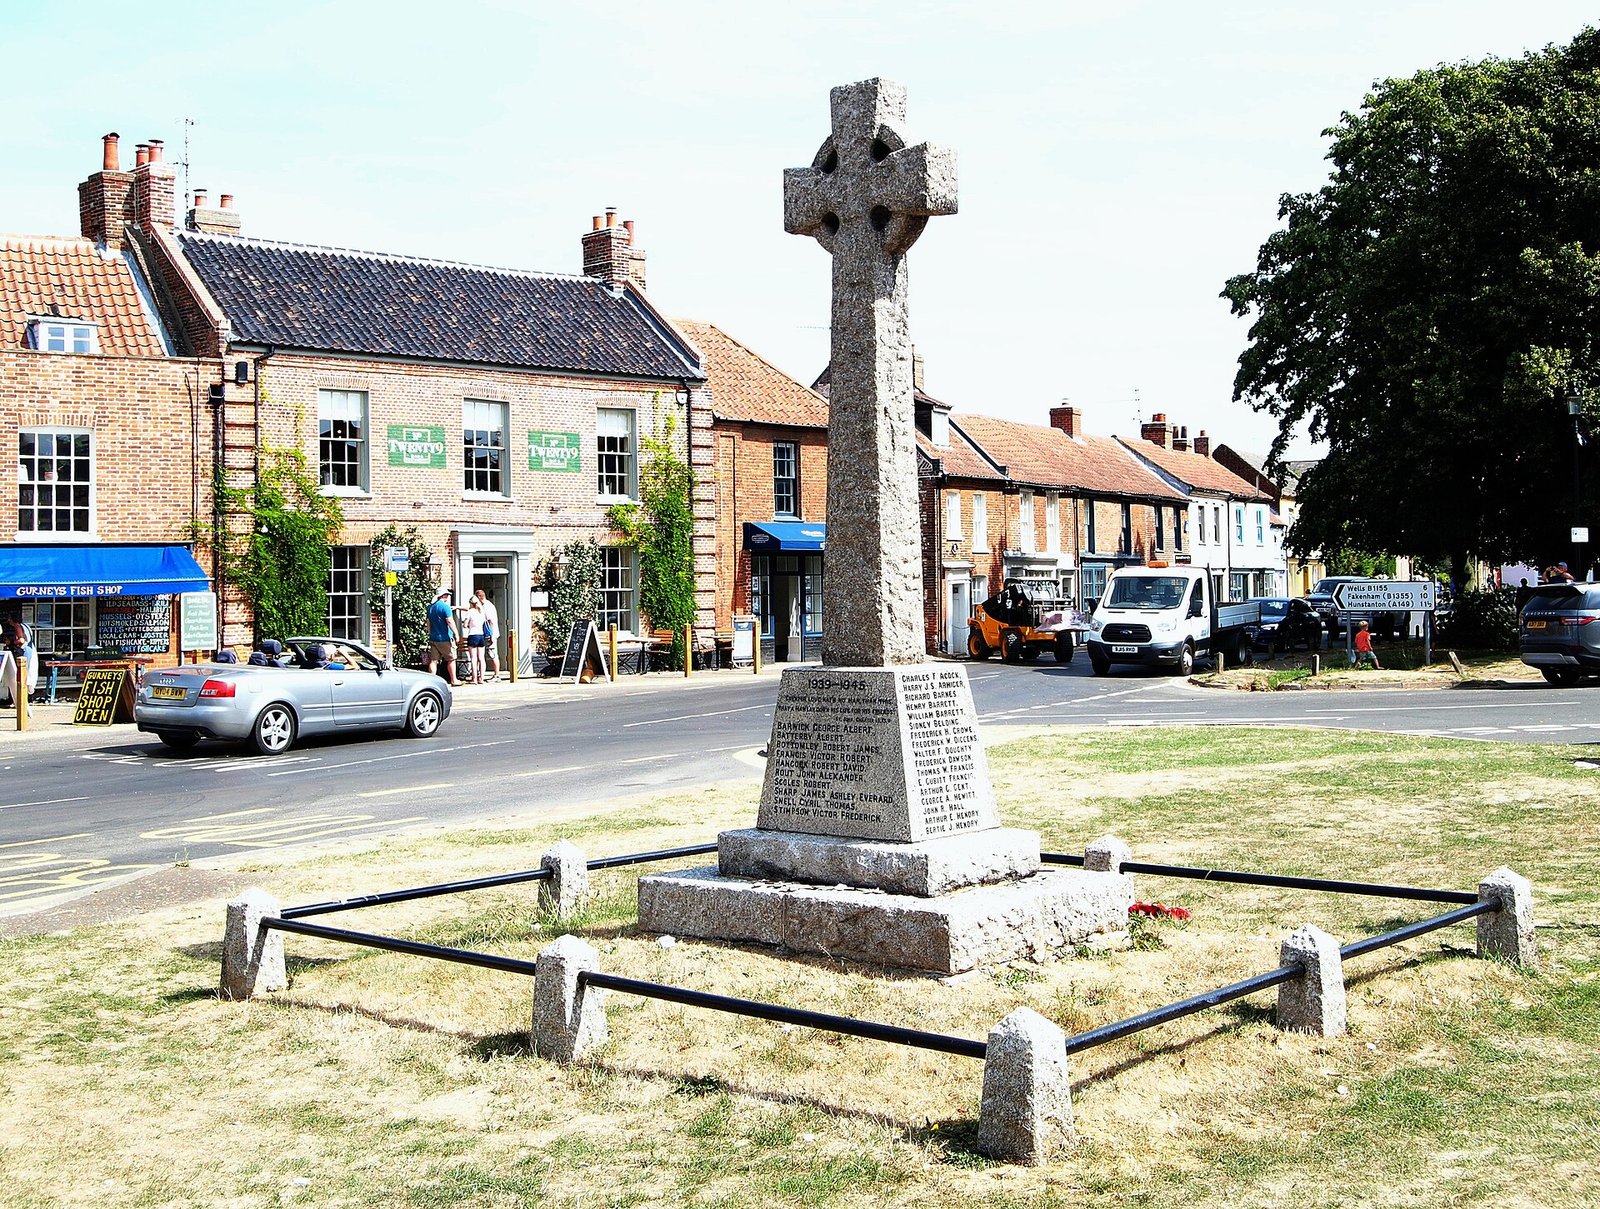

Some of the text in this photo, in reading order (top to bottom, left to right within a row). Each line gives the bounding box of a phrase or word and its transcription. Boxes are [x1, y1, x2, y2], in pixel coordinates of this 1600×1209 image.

[16, 585, 122, 596] GURNEYS FISH SHOP
[87, 672, 123, 680] GURNEYS
[902, 674, 930, 682] CHARLES
[84, 681, 115, 695] FISH
[905, 692, 930, 701] RICHARD
[80, 695, 112, 709] SHOP
[76, 709, 108, 722] OPEN
[907, 712, 934, 720] WILLIAM
[777, 722, 809, 731] BARWICK
[813, 723, 840, 732] GEORGE
[909, 721, 931, 730] SIDNEY
[776, 731, 812, 740] BATTERBY
[910, 730, 943, 739] FREDERICK
[776, 741, 819, 750] BOTTOMLEY
[823, 743, 850, 752] ROBERT
[912, 739, 944, 748] FREDERICK
[776, 750, 807, 758] FRANCIS
[810, 752, 835, 761] VICTOR
[913, 749, 935, 758] WALTER
[776, 759, 808, 768] HANCOCK
[812, 761, 840, 770] ROBERT
[915, 757, 946, 767] FREDERICK
[775, 769, 794, 777] ROUT
[797, 770, 816, 778] JOHN
[917, 768, 940, 777] THOMAS
[775, 778, 800, 787] SCOLES
[774, 787, 893, 803] SHARP JAMES ASHLEY EVERARD
[920, 786, 943, 796] ARTHUR
[774, 796, 796, 805] SNELL
[799, 799, 820, 808] CYRIL
[921, 796, 943, 805] GEORGE
[774, 806, 809, 816] STIMPSON
[812, 809, 838, 818] VICTOR
[925, 815, 948, 824] ARTHUR
[925, 825, 945, 834] BERTIE
